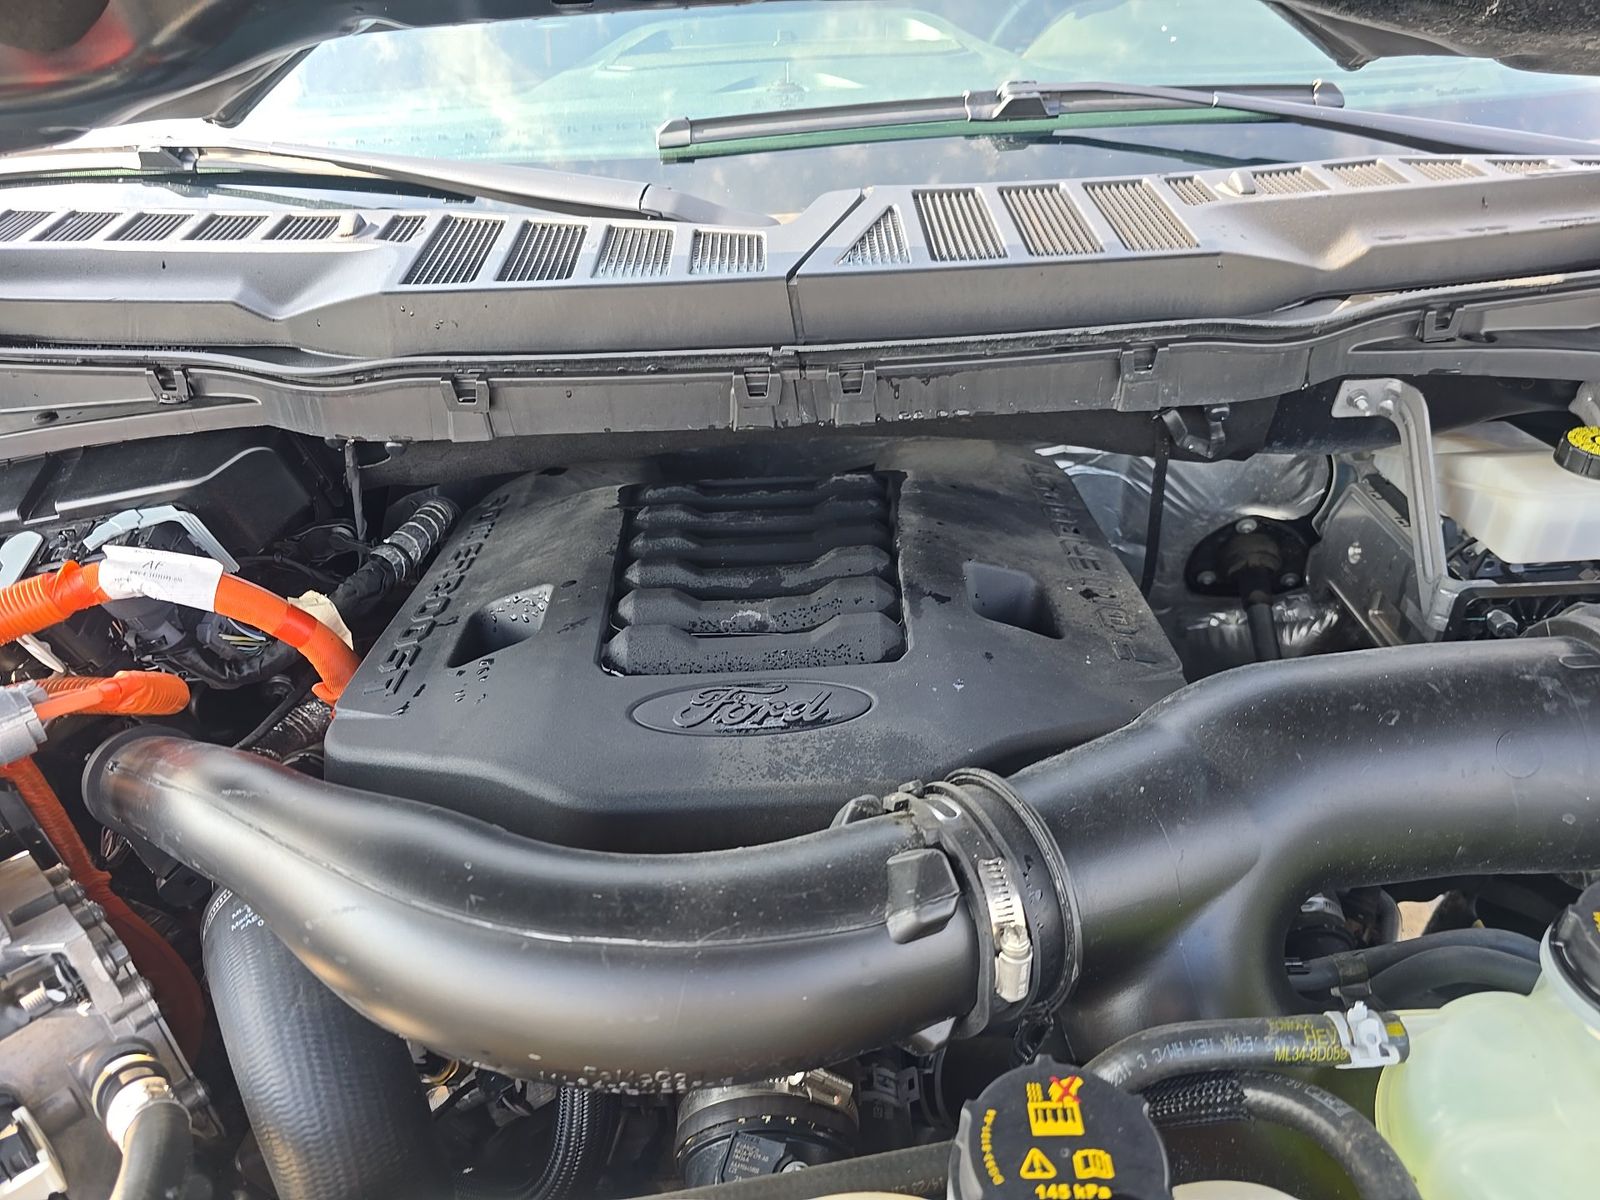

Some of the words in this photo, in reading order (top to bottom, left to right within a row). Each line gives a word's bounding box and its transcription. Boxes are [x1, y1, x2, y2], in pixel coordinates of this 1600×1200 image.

[671, 683, 834, 728] Ford
[1304, 1023, 1337, 1046] HEV
[1034, 1183, 1072, 1200] 145
[1073, 1183, 1112, 1200] kPa
